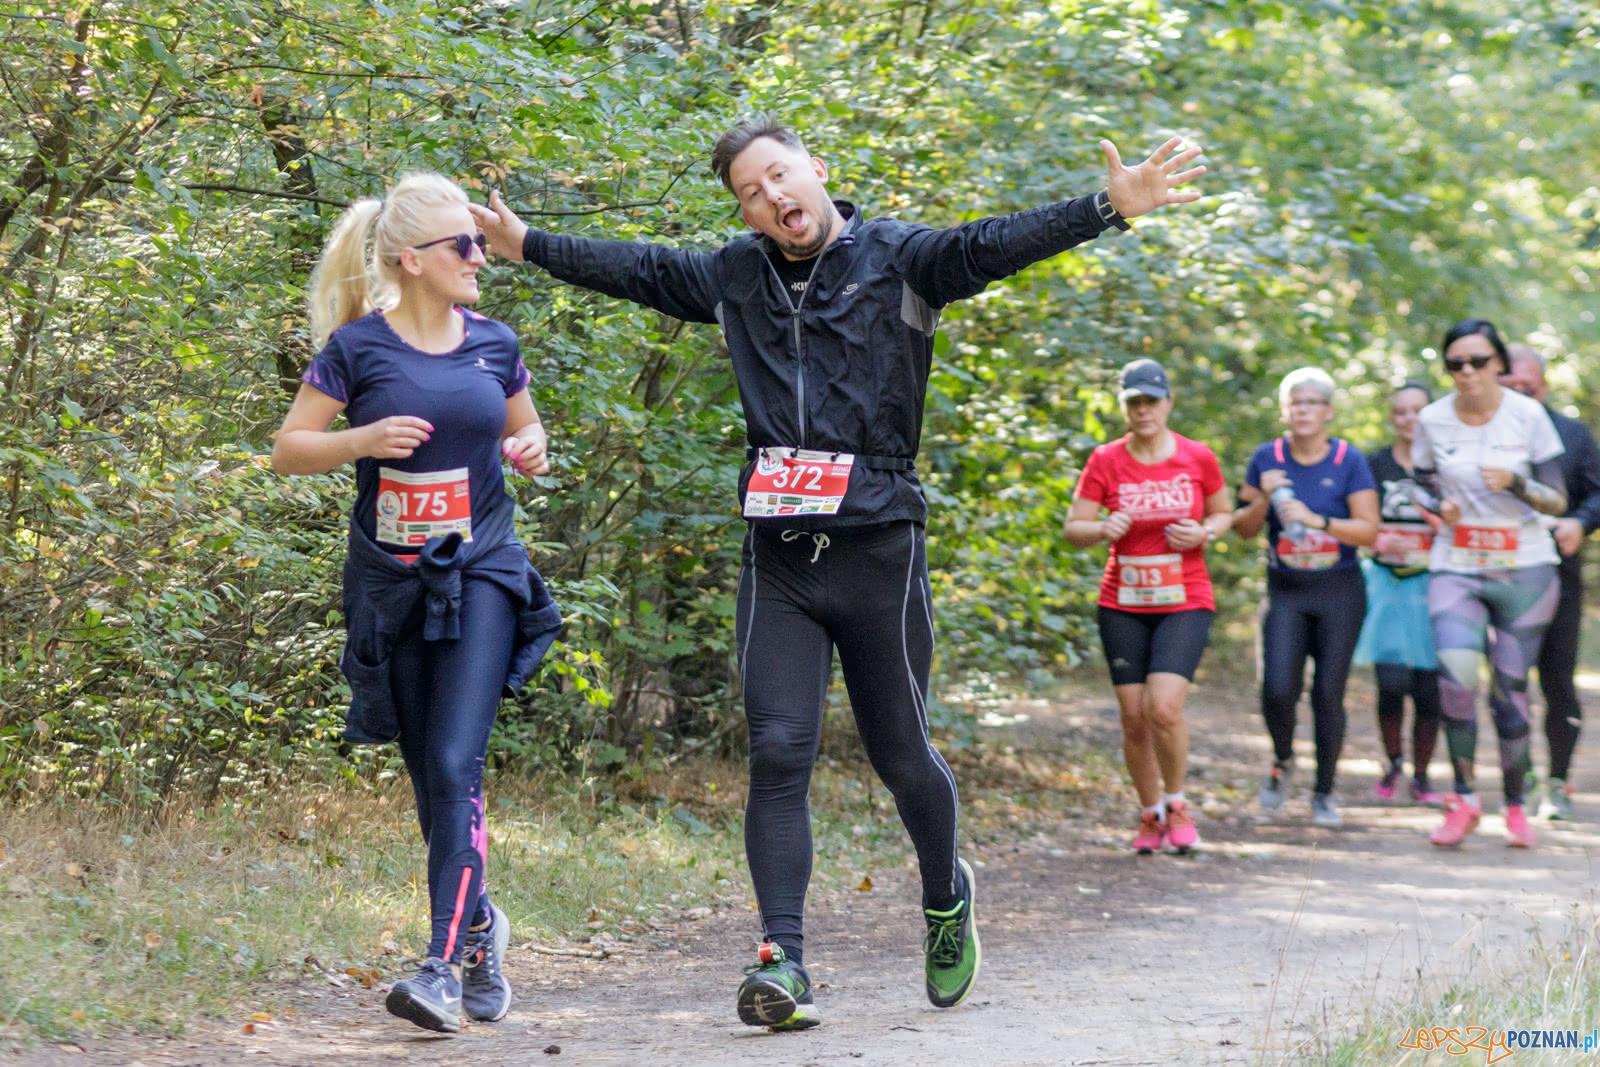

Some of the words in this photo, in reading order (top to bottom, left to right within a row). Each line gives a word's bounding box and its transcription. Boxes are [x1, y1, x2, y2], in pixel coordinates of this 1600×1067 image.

[773, 465, 823, 490] 372
[400, 492, 448, 516] 175
[1140, 568, 1162, 585] 13
